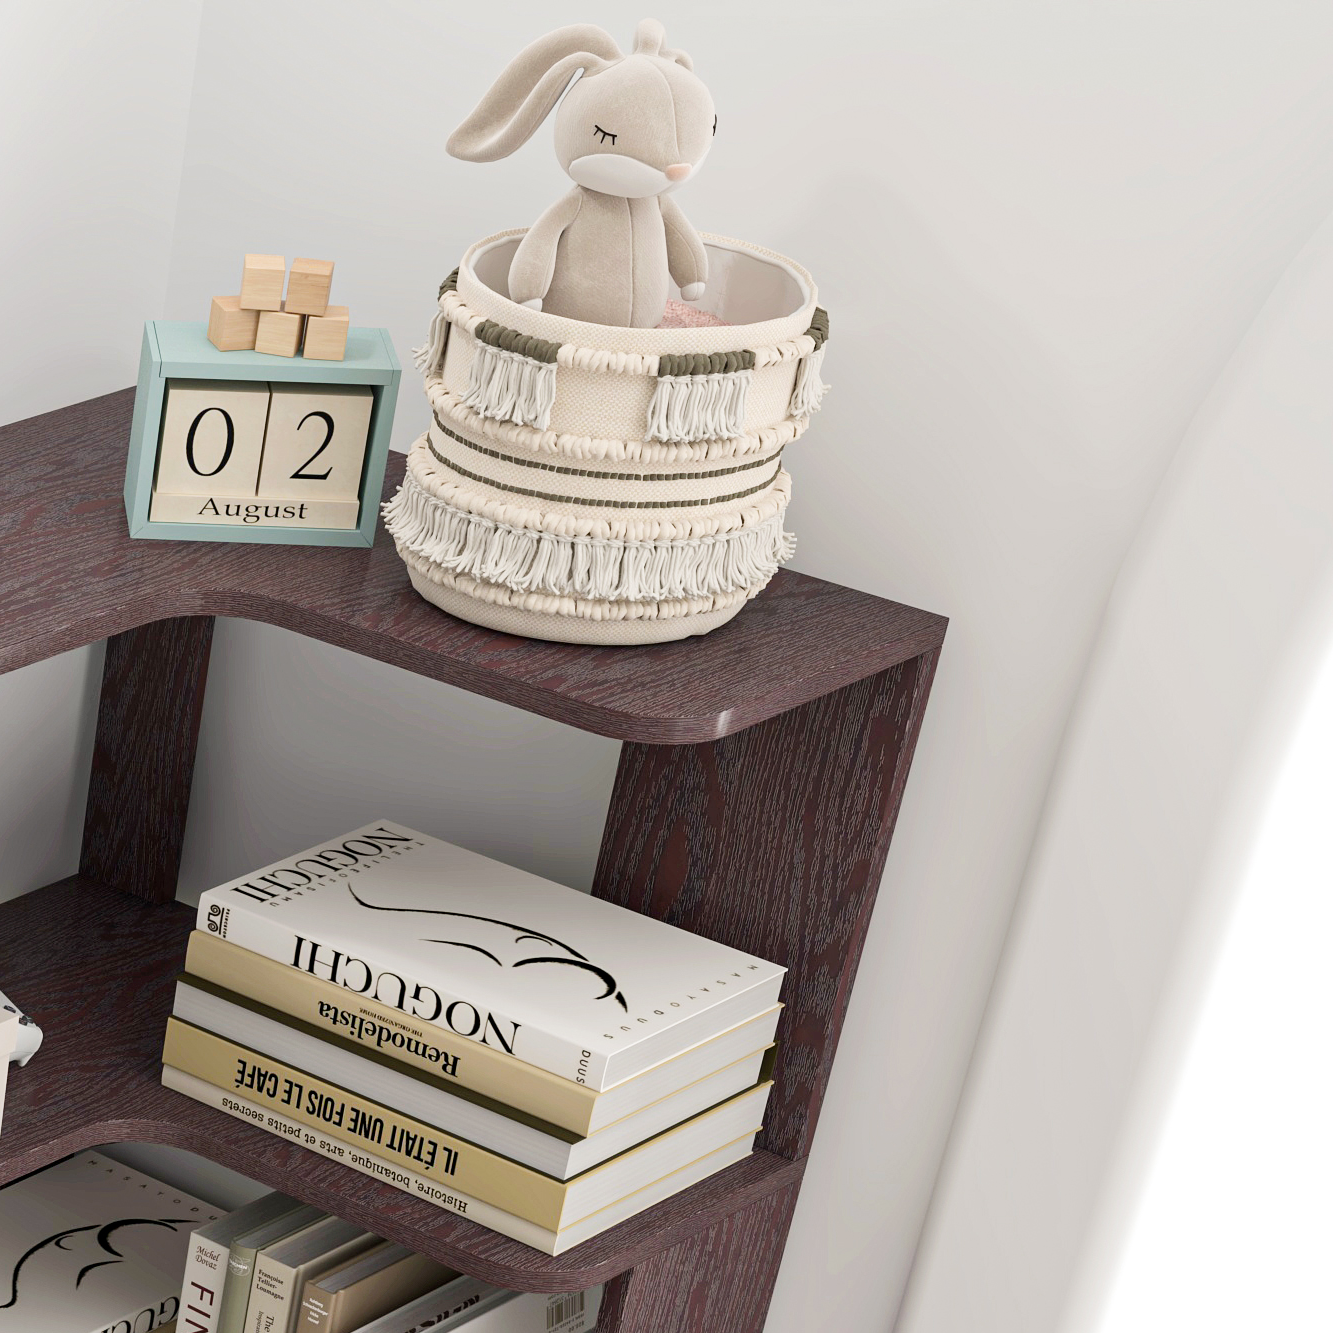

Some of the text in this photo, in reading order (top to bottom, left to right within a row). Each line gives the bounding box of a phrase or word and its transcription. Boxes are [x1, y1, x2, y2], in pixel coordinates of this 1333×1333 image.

[185, 407, 335, 480] 0 2
[198, 498, 309, 525] August
[231, 827, 414, 904] NOGUCHI
[290, 935, 522, 1056] NOGUCHI
[317, 1000, 461, 1078] Remodelista
[576, 1049, 592, 1085] DUUS
[221, 1096, 264, 1124] secrets
[235, 1059, 458, 1176] IL ÉTAIT UNE FOIS LE CAFÉ
[267, 1116, 300, 1140] petits
[320, 1138, 344, 1157] arts
[348, 1150, 410, 1188] botanique,
[415, 1181, 468, 1213] Histoire,
